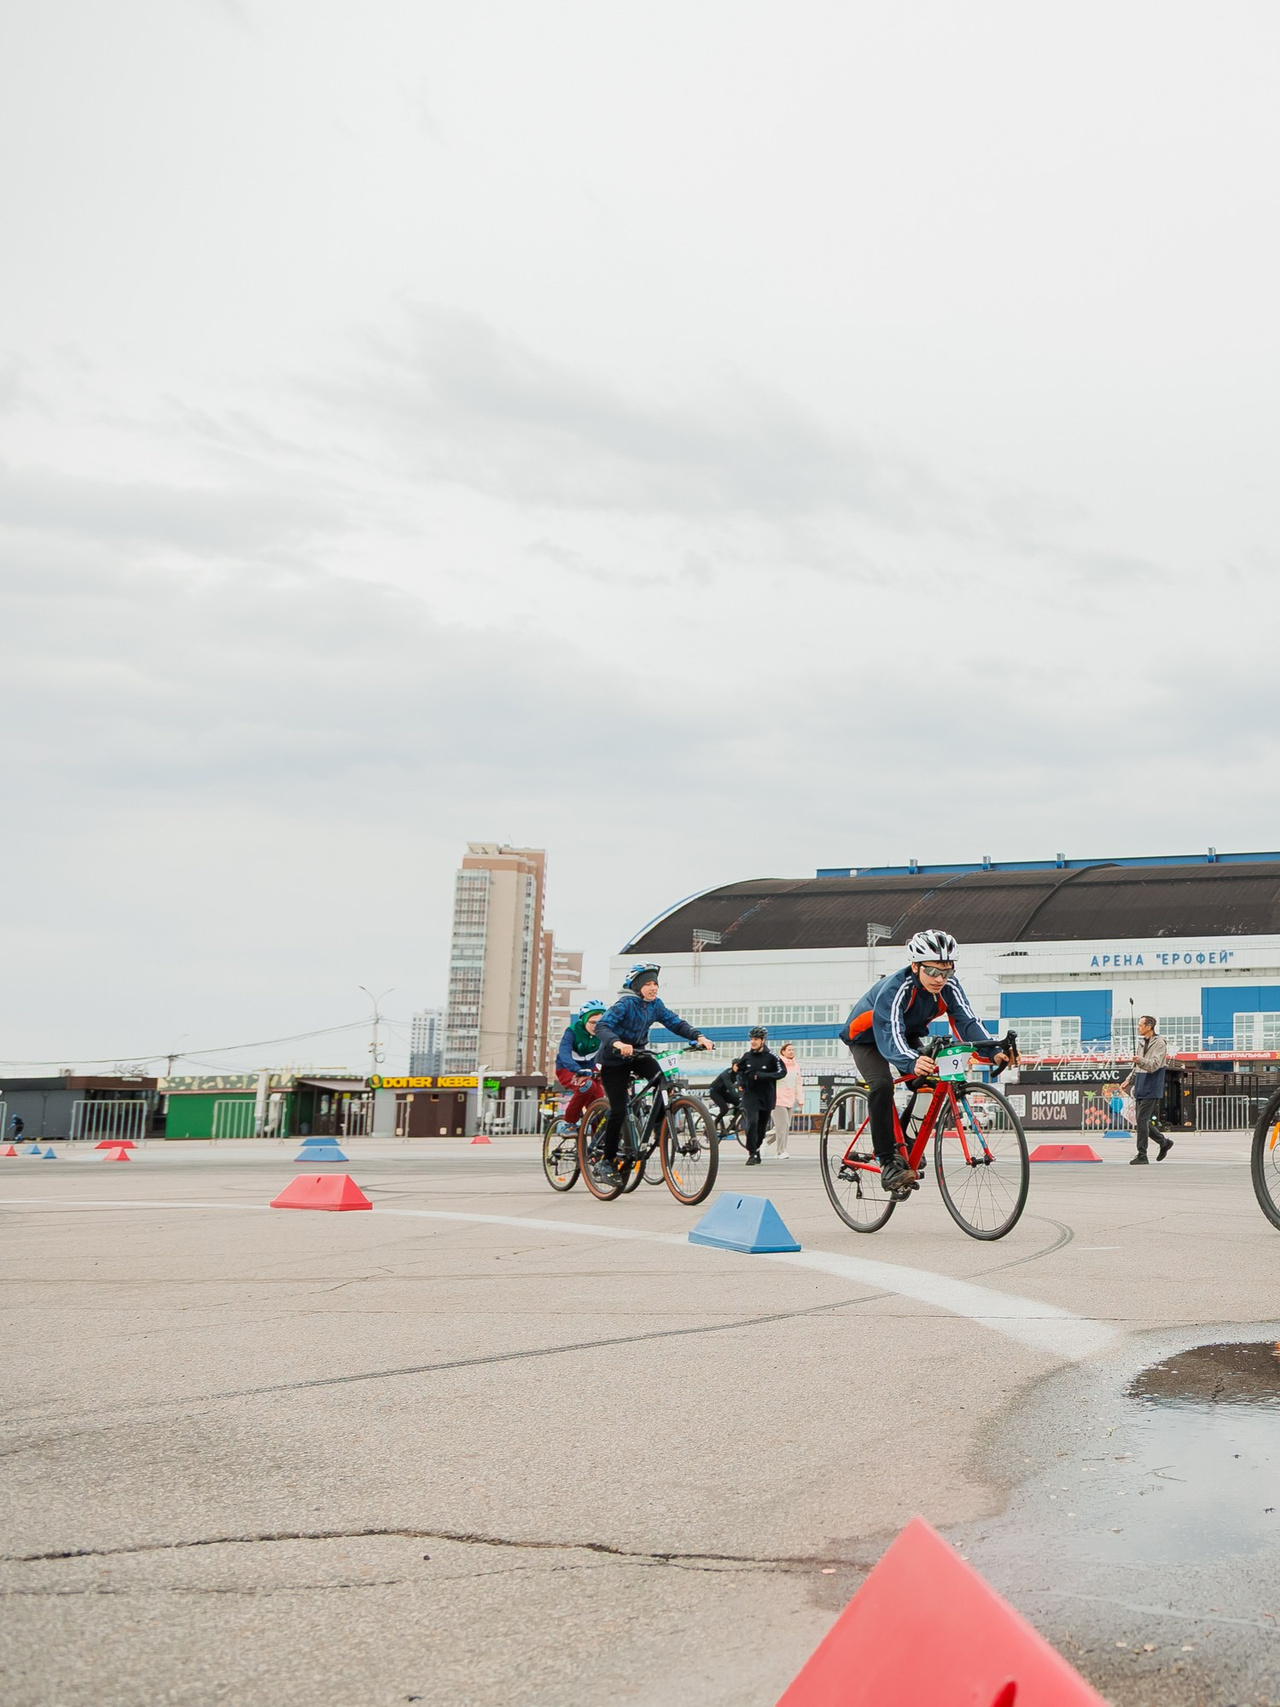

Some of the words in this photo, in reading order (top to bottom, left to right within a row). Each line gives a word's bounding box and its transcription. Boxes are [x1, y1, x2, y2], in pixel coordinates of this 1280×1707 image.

[1090, 954, 1144, 967] АРЕНА
[1156, 950, 1234, 966] "ЕРОФЕЙ"
[668, 1057, 677, 1067] 87
[1052, 1070, 1120, 1081] КЕБАБ-ХАУС
[1031, 1090, 1080, 1105] ИСТОРИЯ
[1031, 1106, 1067, 1120] ВКУСА
